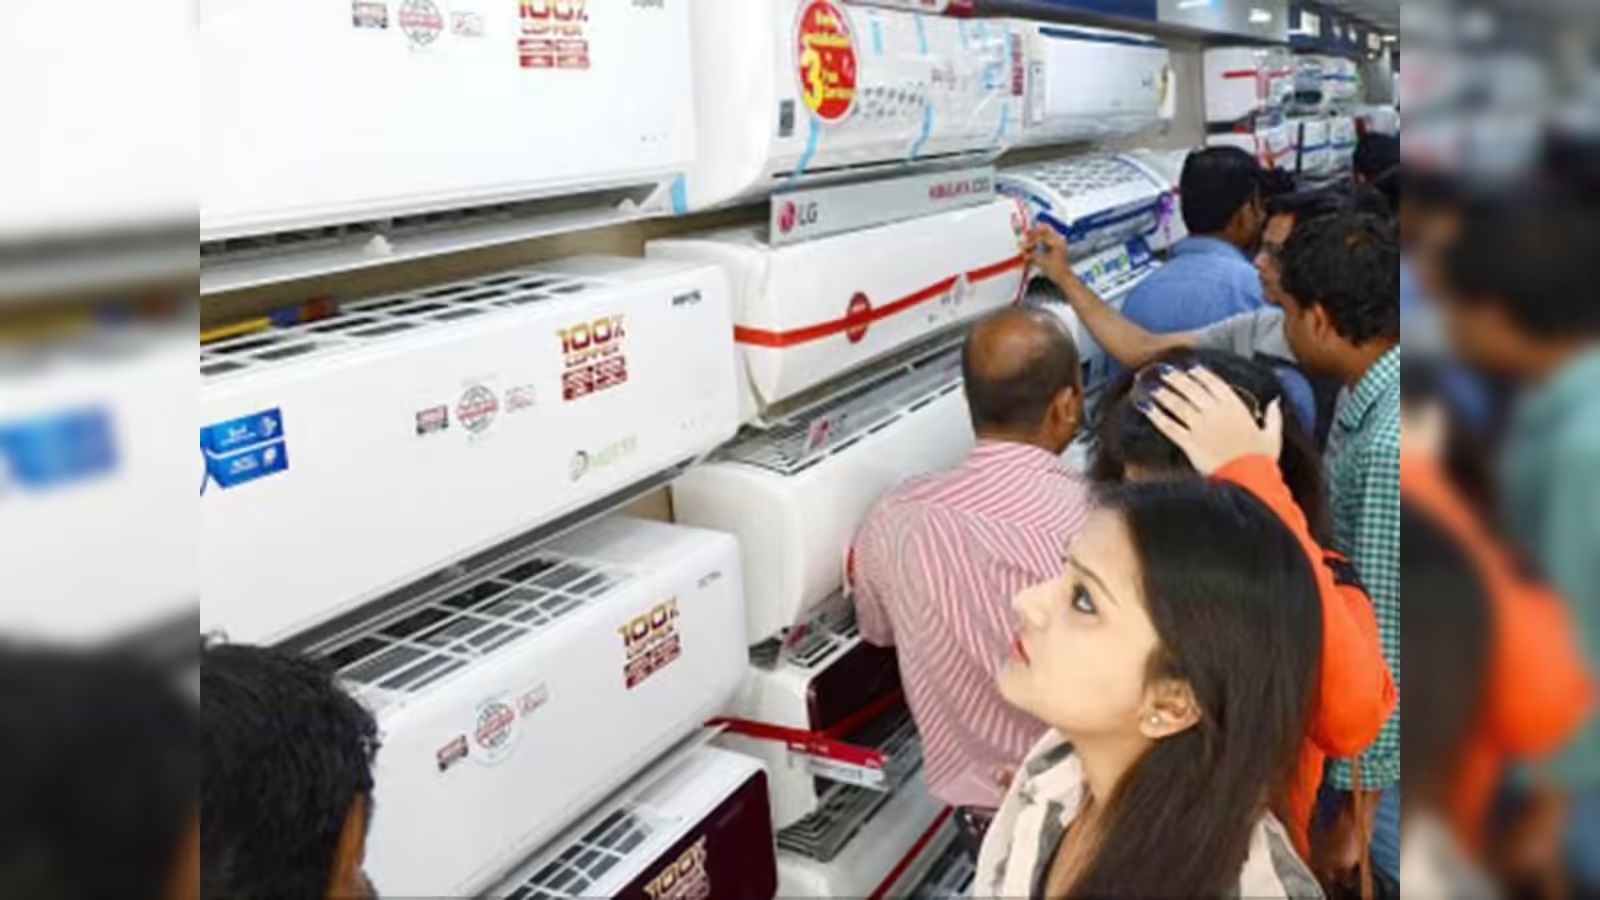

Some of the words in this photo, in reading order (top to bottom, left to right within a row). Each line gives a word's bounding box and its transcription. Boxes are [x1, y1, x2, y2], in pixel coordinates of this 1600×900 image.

[801, 50, 824, 112] 3
[799, 203, 818, 226] LG
[556, 314, 626, 353] 100%
[617, 595, 679, 646] 100%
